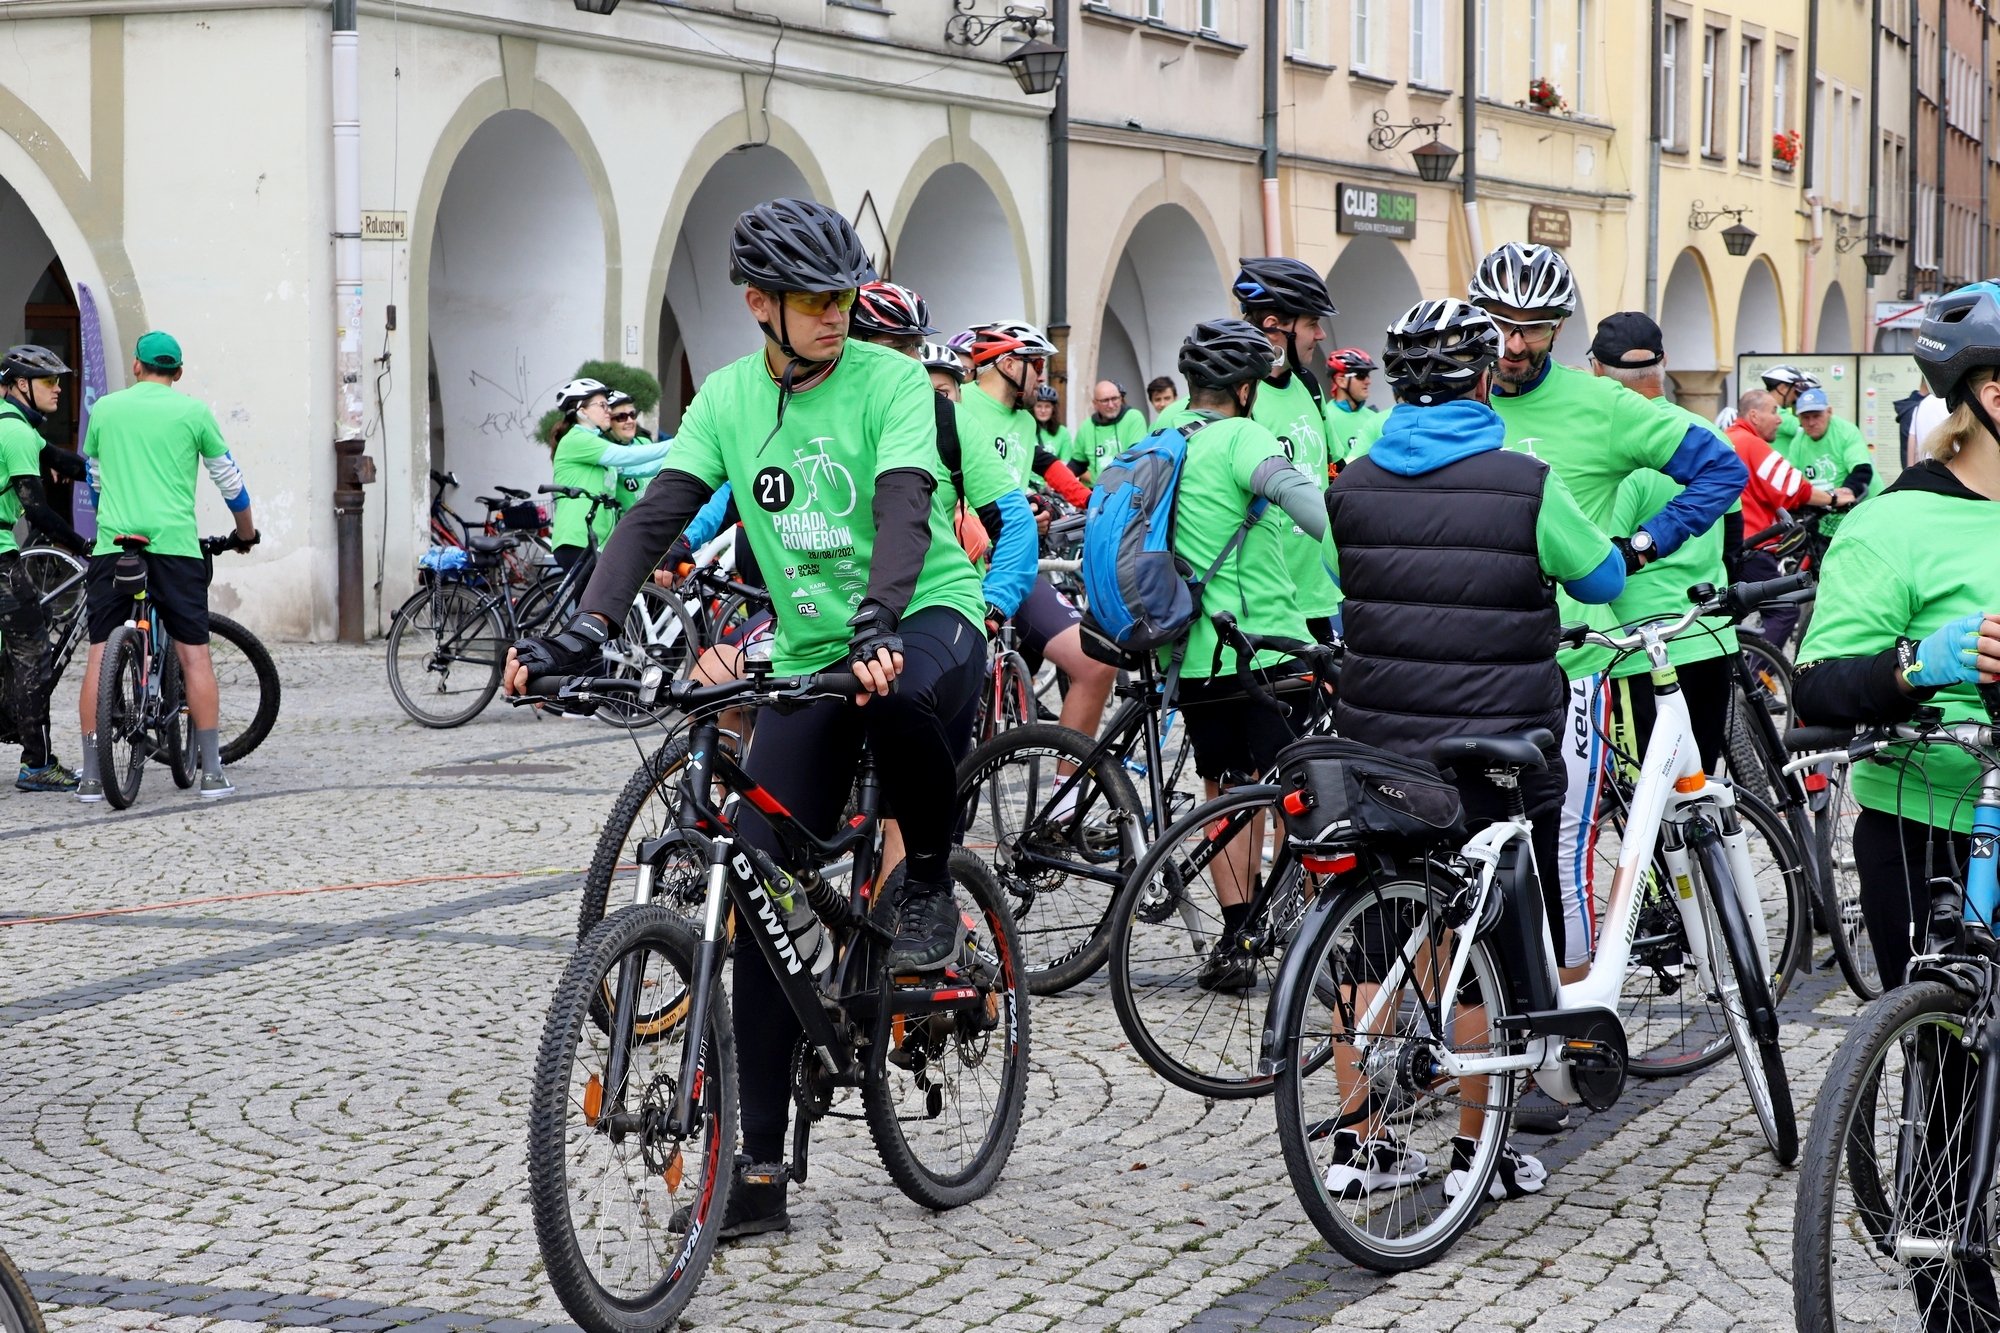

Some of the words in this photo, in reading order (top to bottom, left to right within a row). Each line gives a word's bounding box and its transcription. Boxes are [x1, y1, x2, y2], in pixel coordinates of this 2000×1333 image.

[1344, 188, 1378, 218] CLUB
[1380, 193, 1415, 222] SUSHI
[365, 215, 405, 238] Ratuszowy
[1354, 221, 1373, 231] FUSION
[1374, 223, 1405, 235] RESTAURANT
[625, 477, 638, 490] 21
[760, 473, 786, 503] 21
[772, 511, 829, 533] PARADA
[780, 525, 853, 551] ROWERÓW
[807, 546, 856, 560] 28//08//2021
[797, 562, 820, 571] DOLNY
[1377, 784, 1407, 799] KLS
[1273, 863, 1308, 937] cannond
[1624, 869, 1647, 946] WINORA
[732, 851, 803, 976] BTWIN
[1008, 987, 1018, 1046] TRAIL
[677, 1219, 703, 1276] TRAIL
